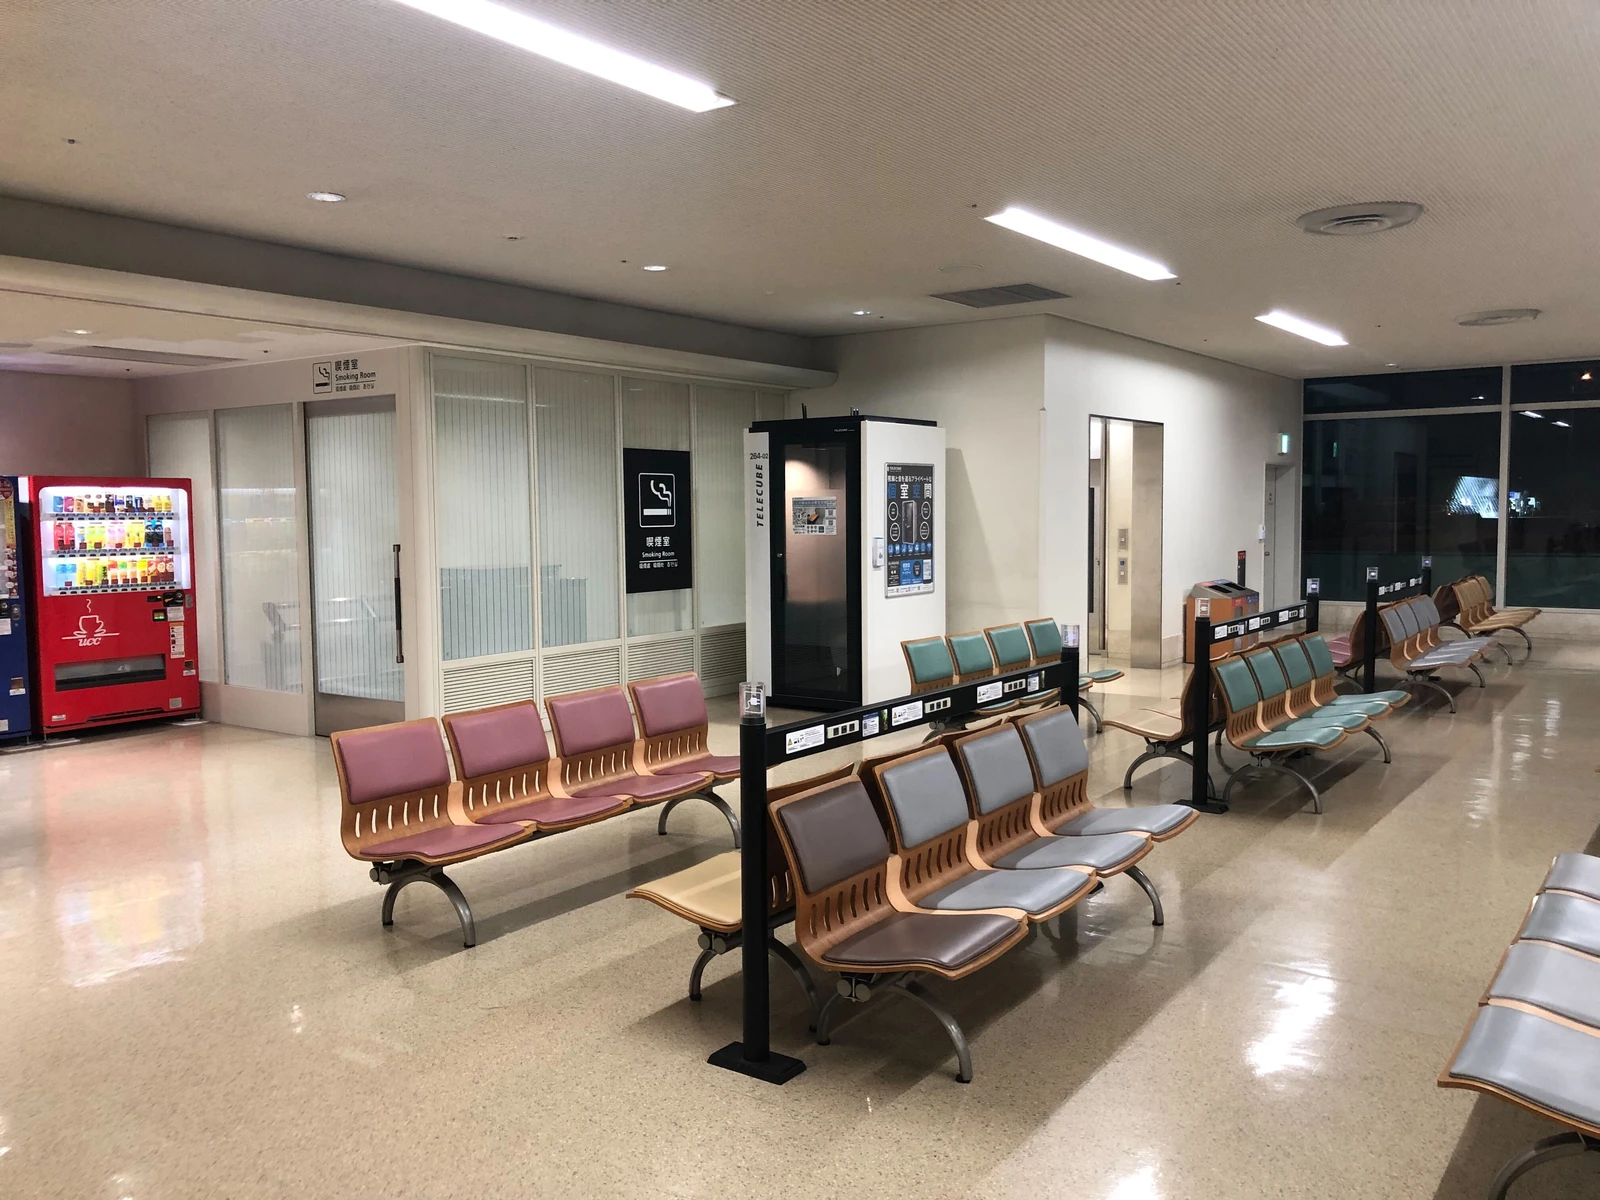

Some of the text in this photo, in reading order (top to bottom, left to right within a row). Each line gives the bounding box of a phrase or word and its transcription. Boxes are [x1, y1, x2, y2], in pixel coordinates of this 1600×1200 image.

[335, 359, 358, 371] 喫煙室
[335, 373, 358, 381] Smoking
[749, 452, 769, 460] 264-02
[755, 463, 764, 527] TELECUBE
[646, 536, 670, 547] 喫煙室
